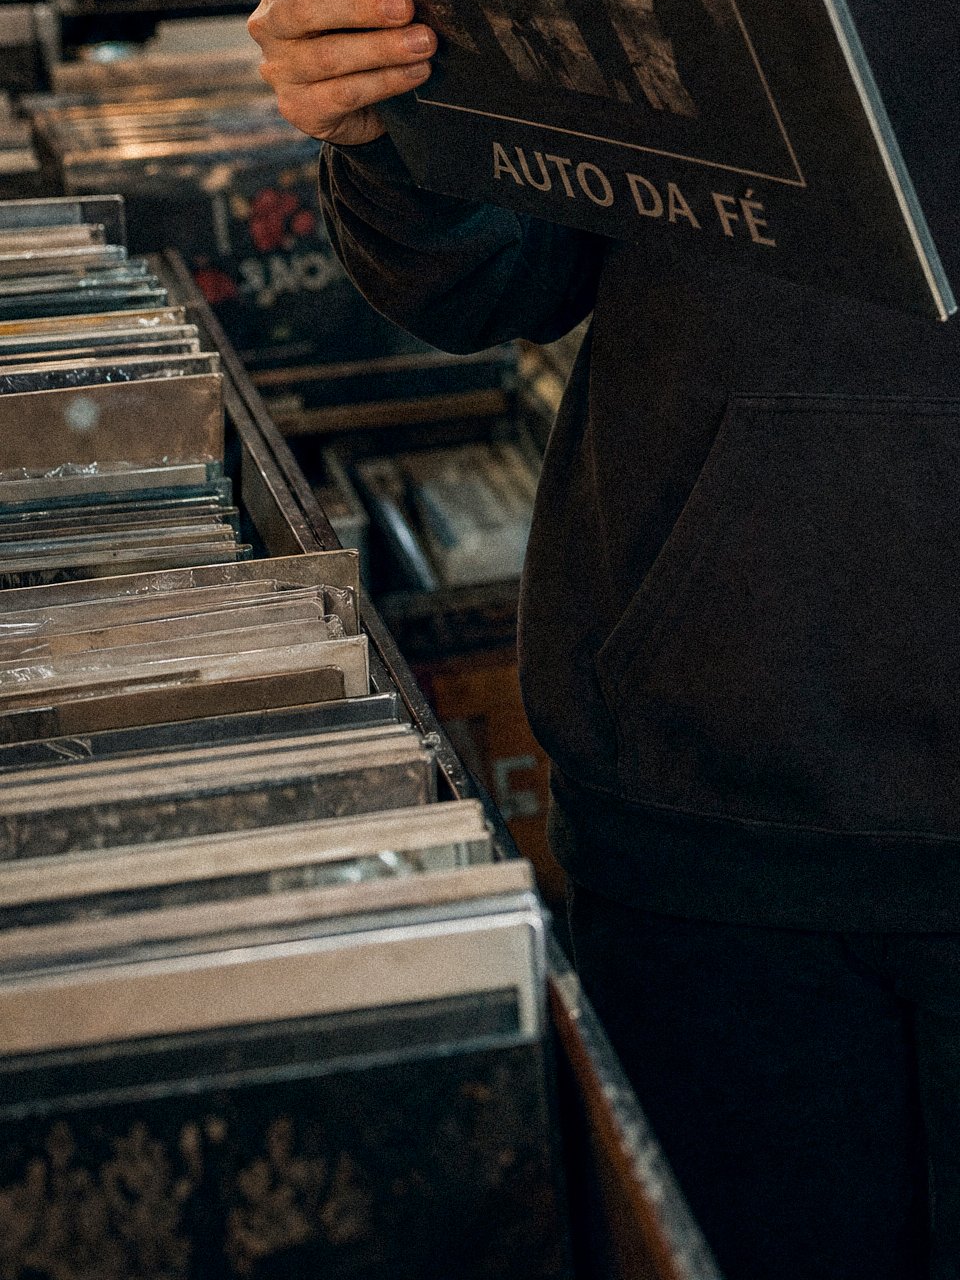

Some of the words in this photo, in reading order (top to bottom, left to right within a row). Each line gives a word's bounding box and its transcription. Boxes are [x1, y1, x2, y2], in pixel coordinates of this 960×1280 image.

[492, 141, 614, 207] AUTO
[625, 172, 701, 230] DA
[712, 188, 777, 248] FÉ
